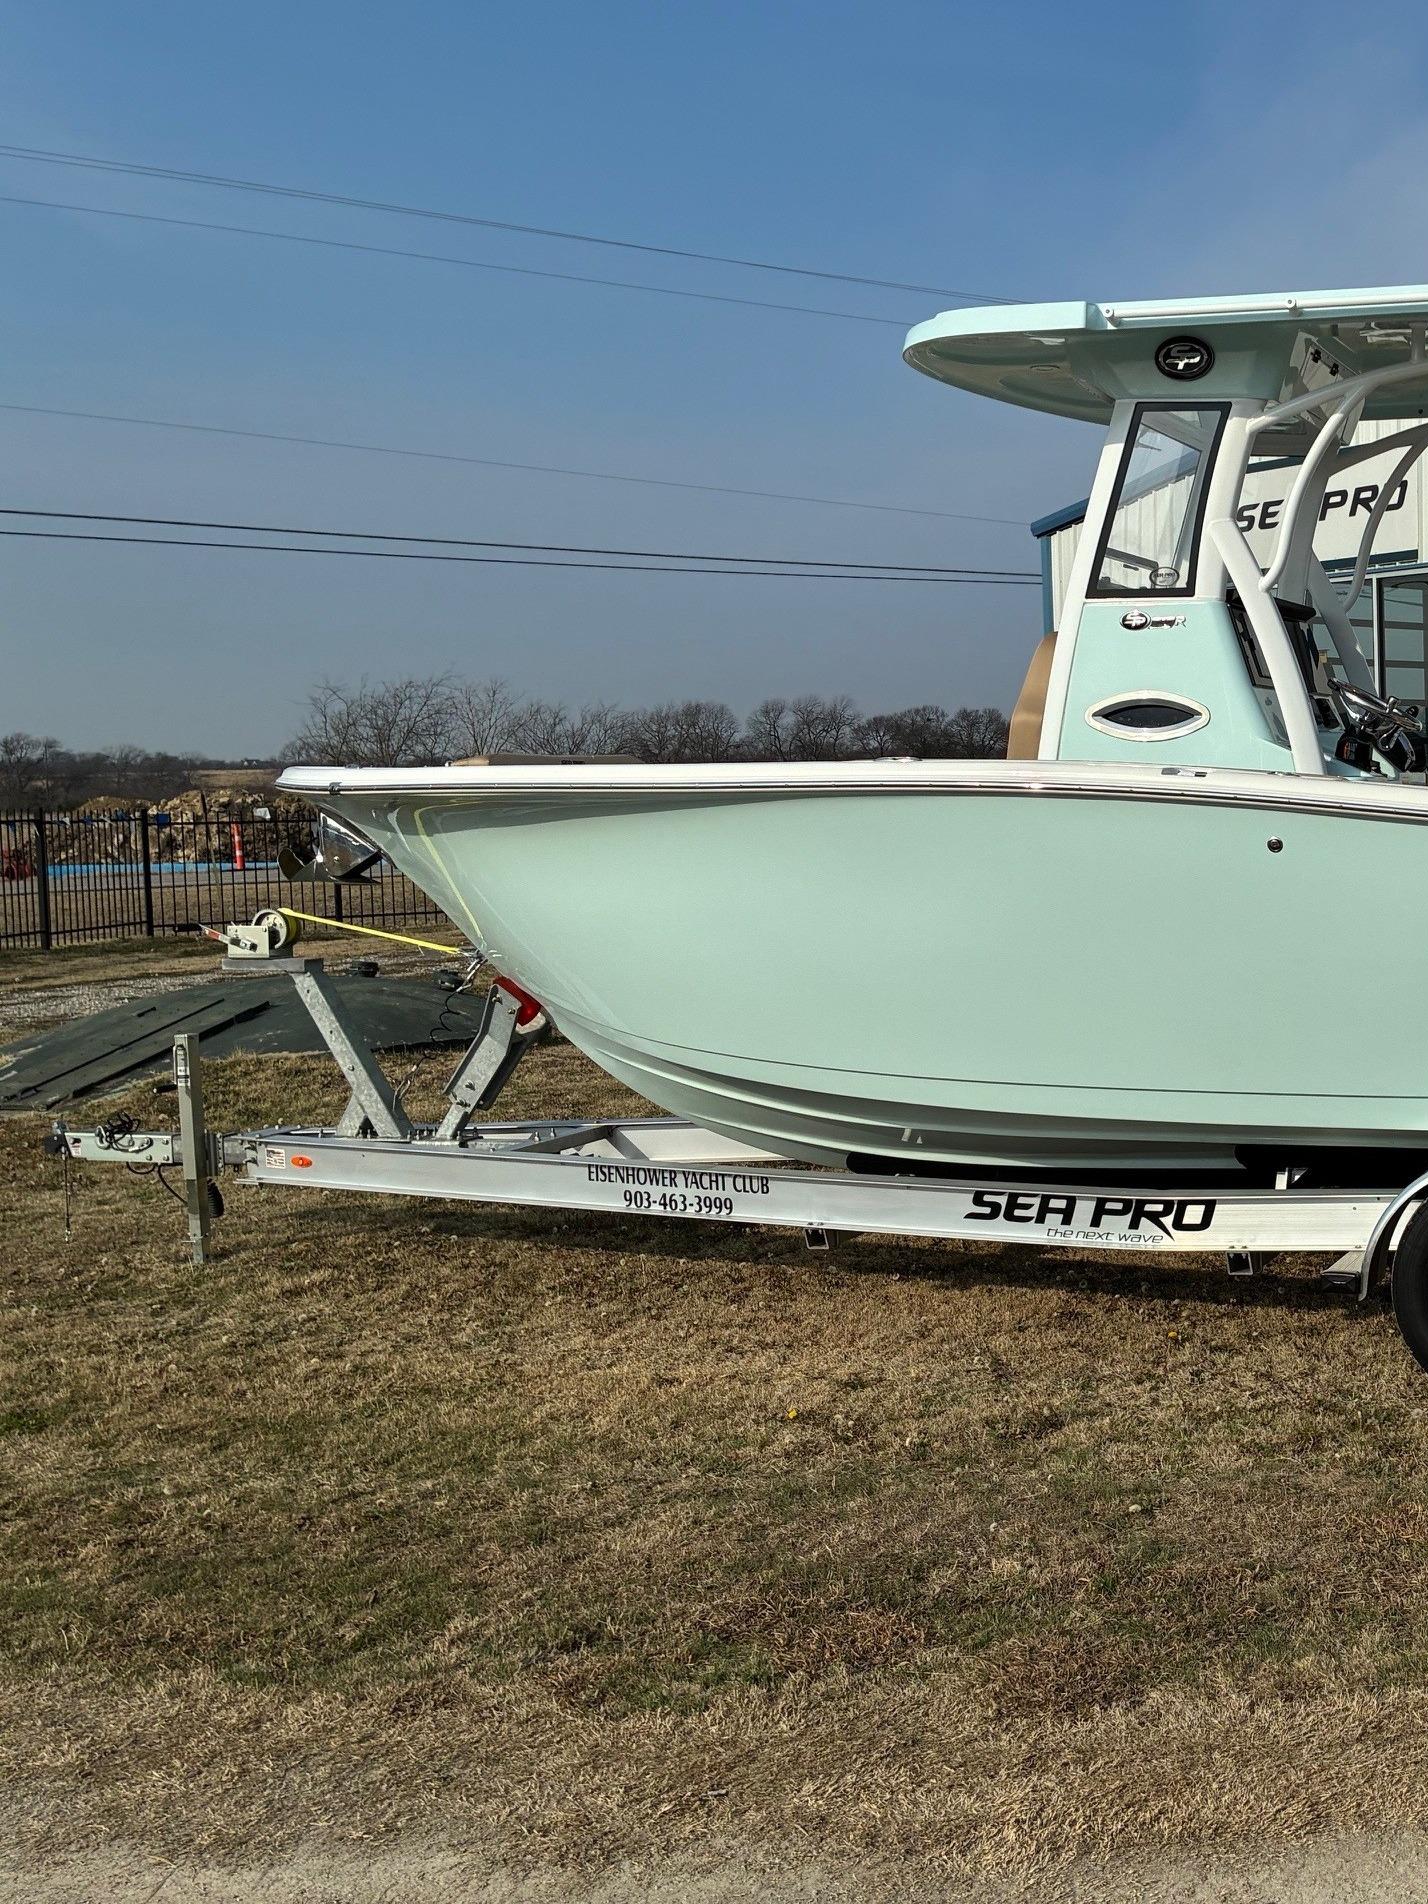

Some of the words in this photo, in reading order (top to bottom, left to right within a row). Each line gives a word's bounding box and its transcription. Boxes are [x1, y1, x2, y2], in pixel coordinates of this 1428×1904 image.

[1236, 498, 1286, 533] SE
[587, 1163, 678, 1188] EISENHOWER
[682, 1169, 727, 1192] YACHT
[732, 1173, 770, 1195] CLUB
[623, 1189, 734, 1216] 903-463-3999
[963, 1189, 1078, 1226] SEA
[1089, 1196, 1218, 1242] PRO
[1046, 1228, 1074, 1239] the
[1076, 1230, 1115, 1241] next
[1117, 1233, 1164, 1244] wave
